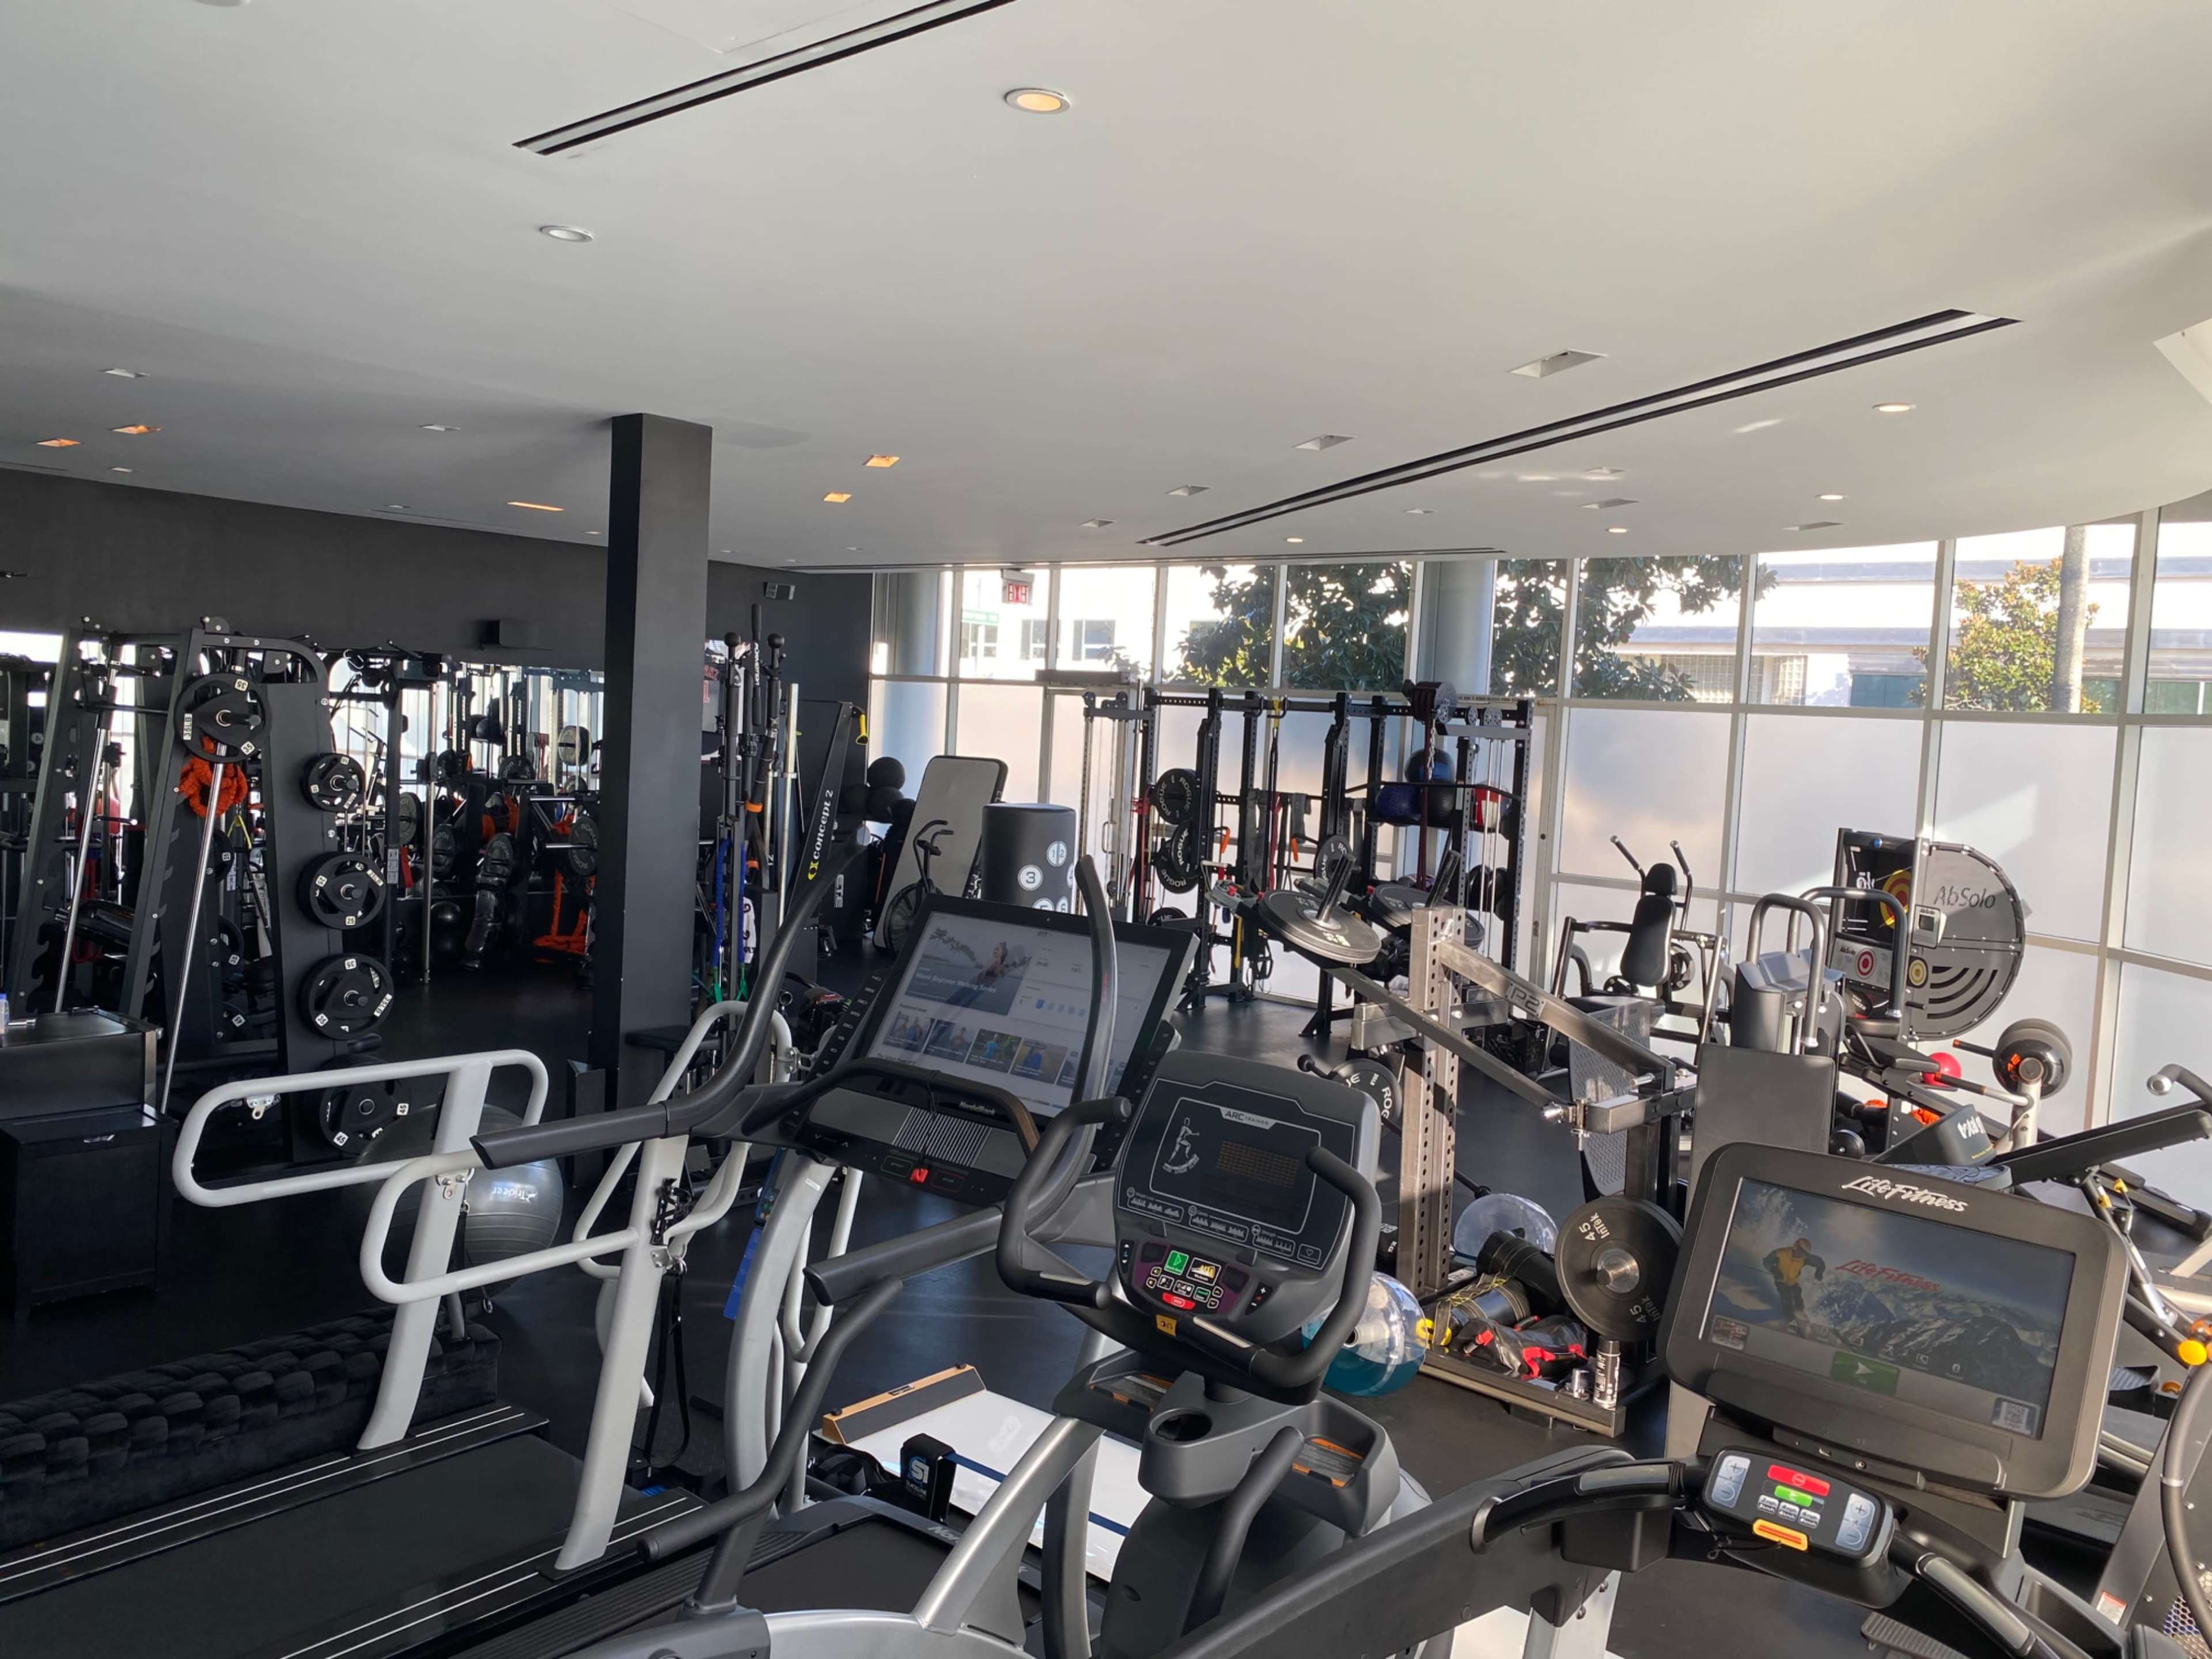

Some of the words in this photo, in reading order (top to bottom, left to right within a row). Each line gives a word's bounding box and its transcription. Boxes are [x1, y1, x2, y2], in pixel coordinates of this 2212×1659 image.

[243, 743, 253, 753] 35
[825, 789, 834, 798] 2
[1059, 849, 1065, 857] 2
[1177, 828, 1189, 866] ROGUE
[1025, 872, 1035, 884] 3
[1161, 868, 1187, 887] ROGUE
[1933, 885, 1997, 909] AbSolo
[1510, 987, 1540, 1013] P2
[1381, 1086, 1393, 1119] ROG
[1225, 1111, 1244, 1121] ARC
[1245, 1116, 1270, 1126] TRAINER
[336, 1134, 347, 1145] 45
[491, 1187, 527, 1200] Trideer
[1579, 1222, 1596, 1241] 45
[1630, 1305, 1647, 1323] 45
